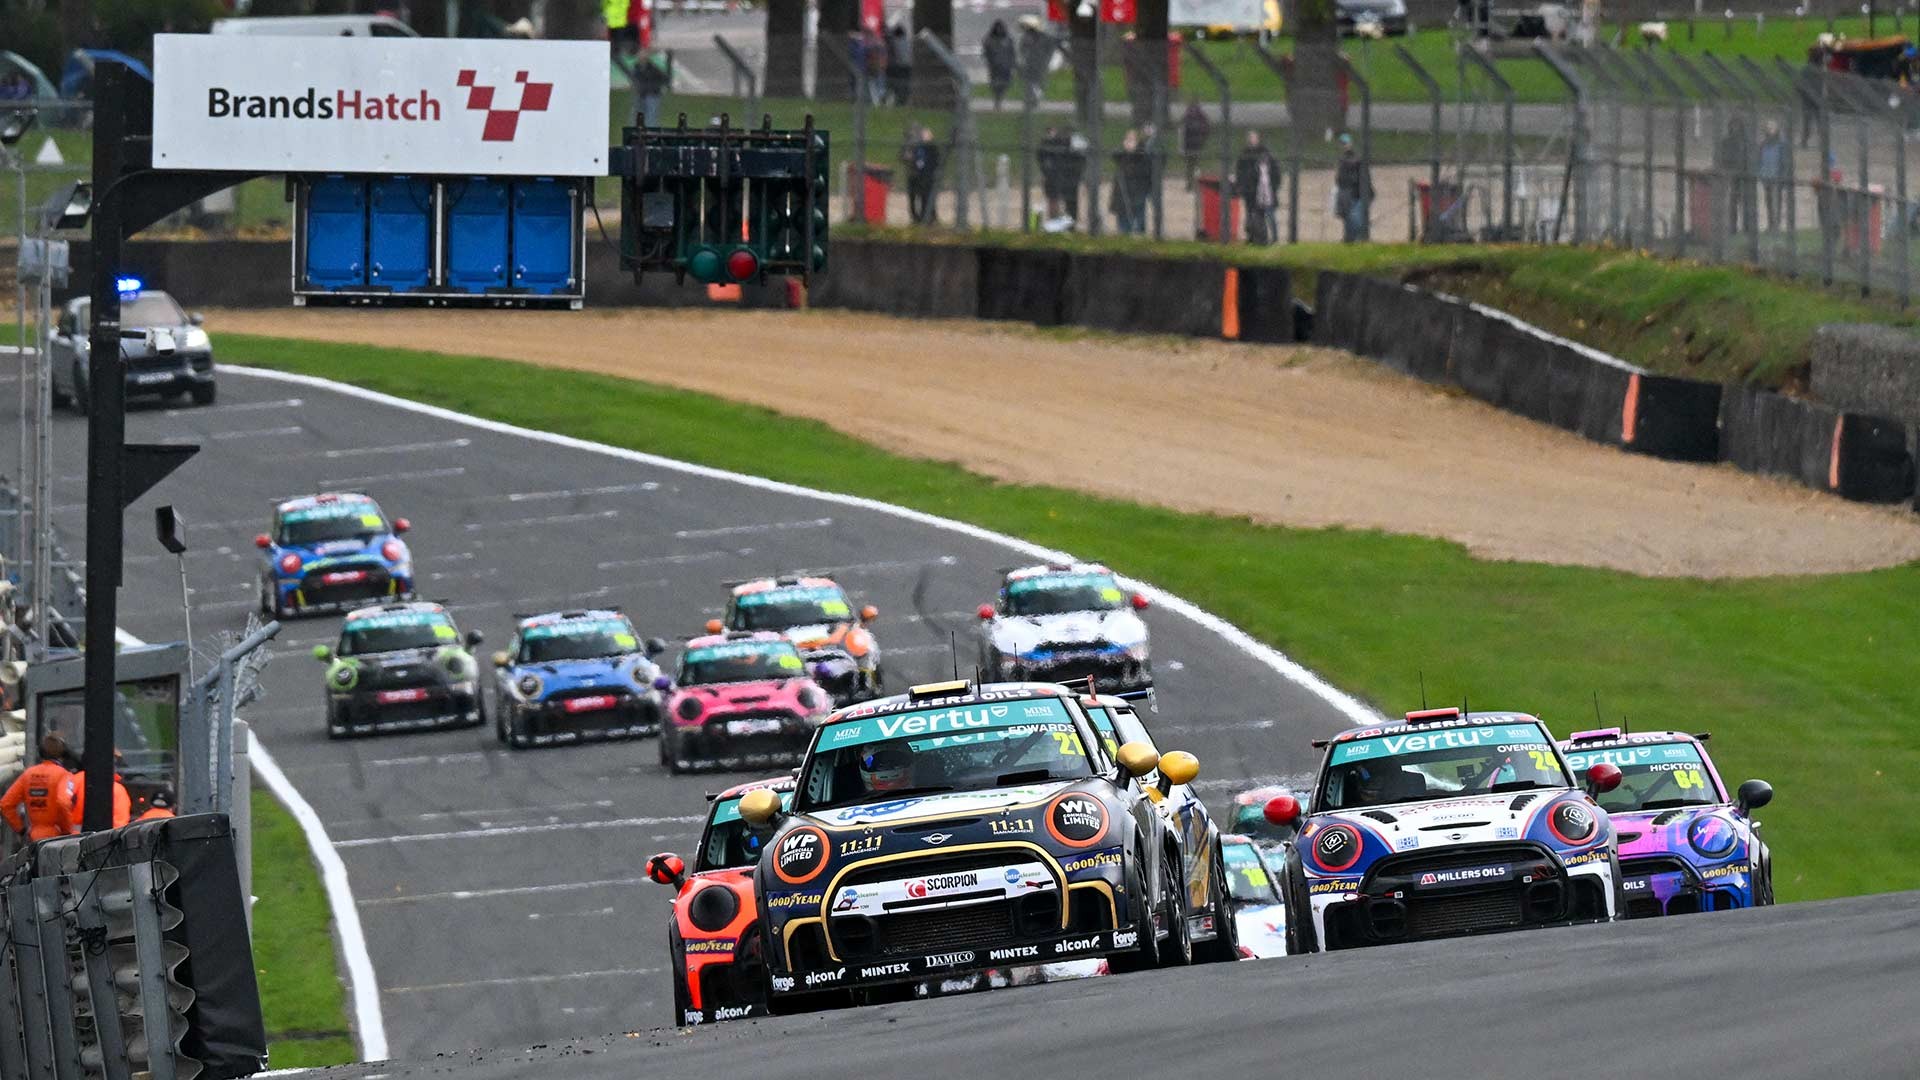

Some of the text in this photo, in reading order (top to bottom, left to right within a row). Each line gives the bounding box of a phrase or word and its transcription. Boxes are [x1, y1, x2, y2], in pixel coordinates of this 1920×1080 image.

[878, 688, 1032, 712] MILLERS OILS
[876, 709, 989, 737] Vertu
[1008, 723, 1076, 735] EDWARDS
[1384, 715, 1515, 734] MILLERS OILS
[1053, 732, 1085, 756] 21
[1383, 730, 1480, 754] Vertu
[1631, 734, 1673, 744] OILS
[1497, 743, 1552, 753] OVENDEN
[1528, 751, 1561, 772] 24
[1565, 750, 1636, 771] ertu
[1650, 762, 1701, 772] HICKTON
[1060, 800, 1097, 815] WP
[988, 818, 1034, 832] 11:11
[1063, 816, 1100, 830] LIMITED
[783, 834, 818, 853] WP
[840, 836, 882, 853] 11:11
[780, 851, 813, 868] LIMITED
[927, 873, 978, 891] SCORPION
[1437, 867, 1505, 882] MILLERS OILS
[1623, 880, 1645, 890] OILS
[989, 945, 1039, 960] MINTEX
[1055, 938, 1090, 953] alcon
[805, 970, 836, 985] alcon
[861, 962, 910, 978] MINTEX
[715, 1006, 743, 1020] alcon
